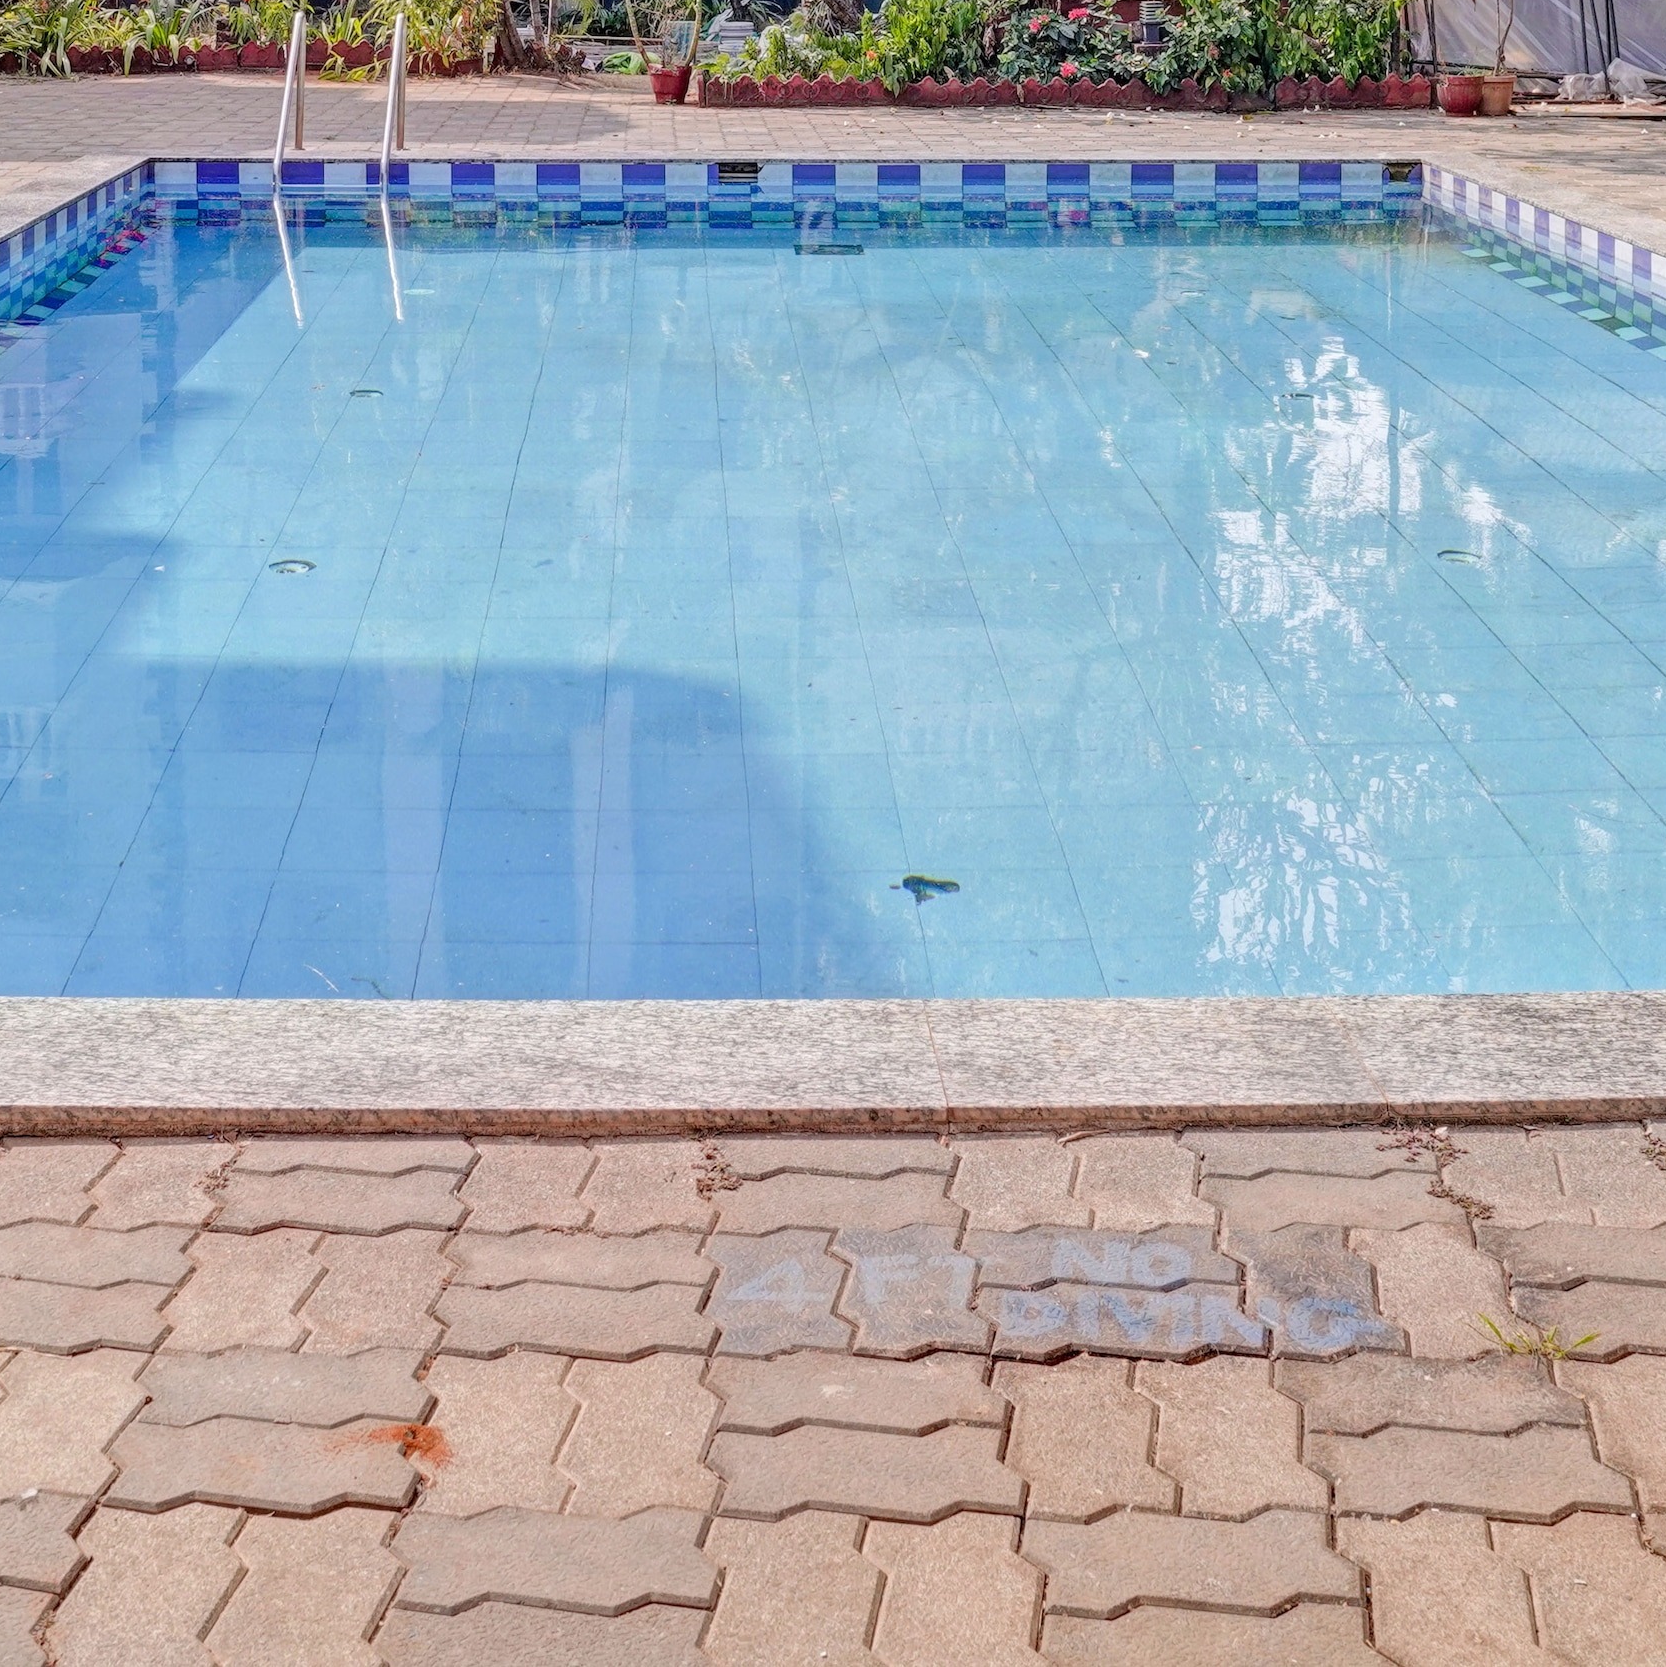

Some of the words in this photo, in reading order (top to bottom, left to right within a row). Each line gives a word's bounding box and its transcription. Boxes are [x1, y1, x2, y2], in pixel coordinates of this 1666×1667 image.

[725, 1257, 832, 1315] 4
[859, 1251, 994, 1308] FT
[1051, 1238, 1193, 1289] NO
[999, 1288, 1391, 1350] DIVING
